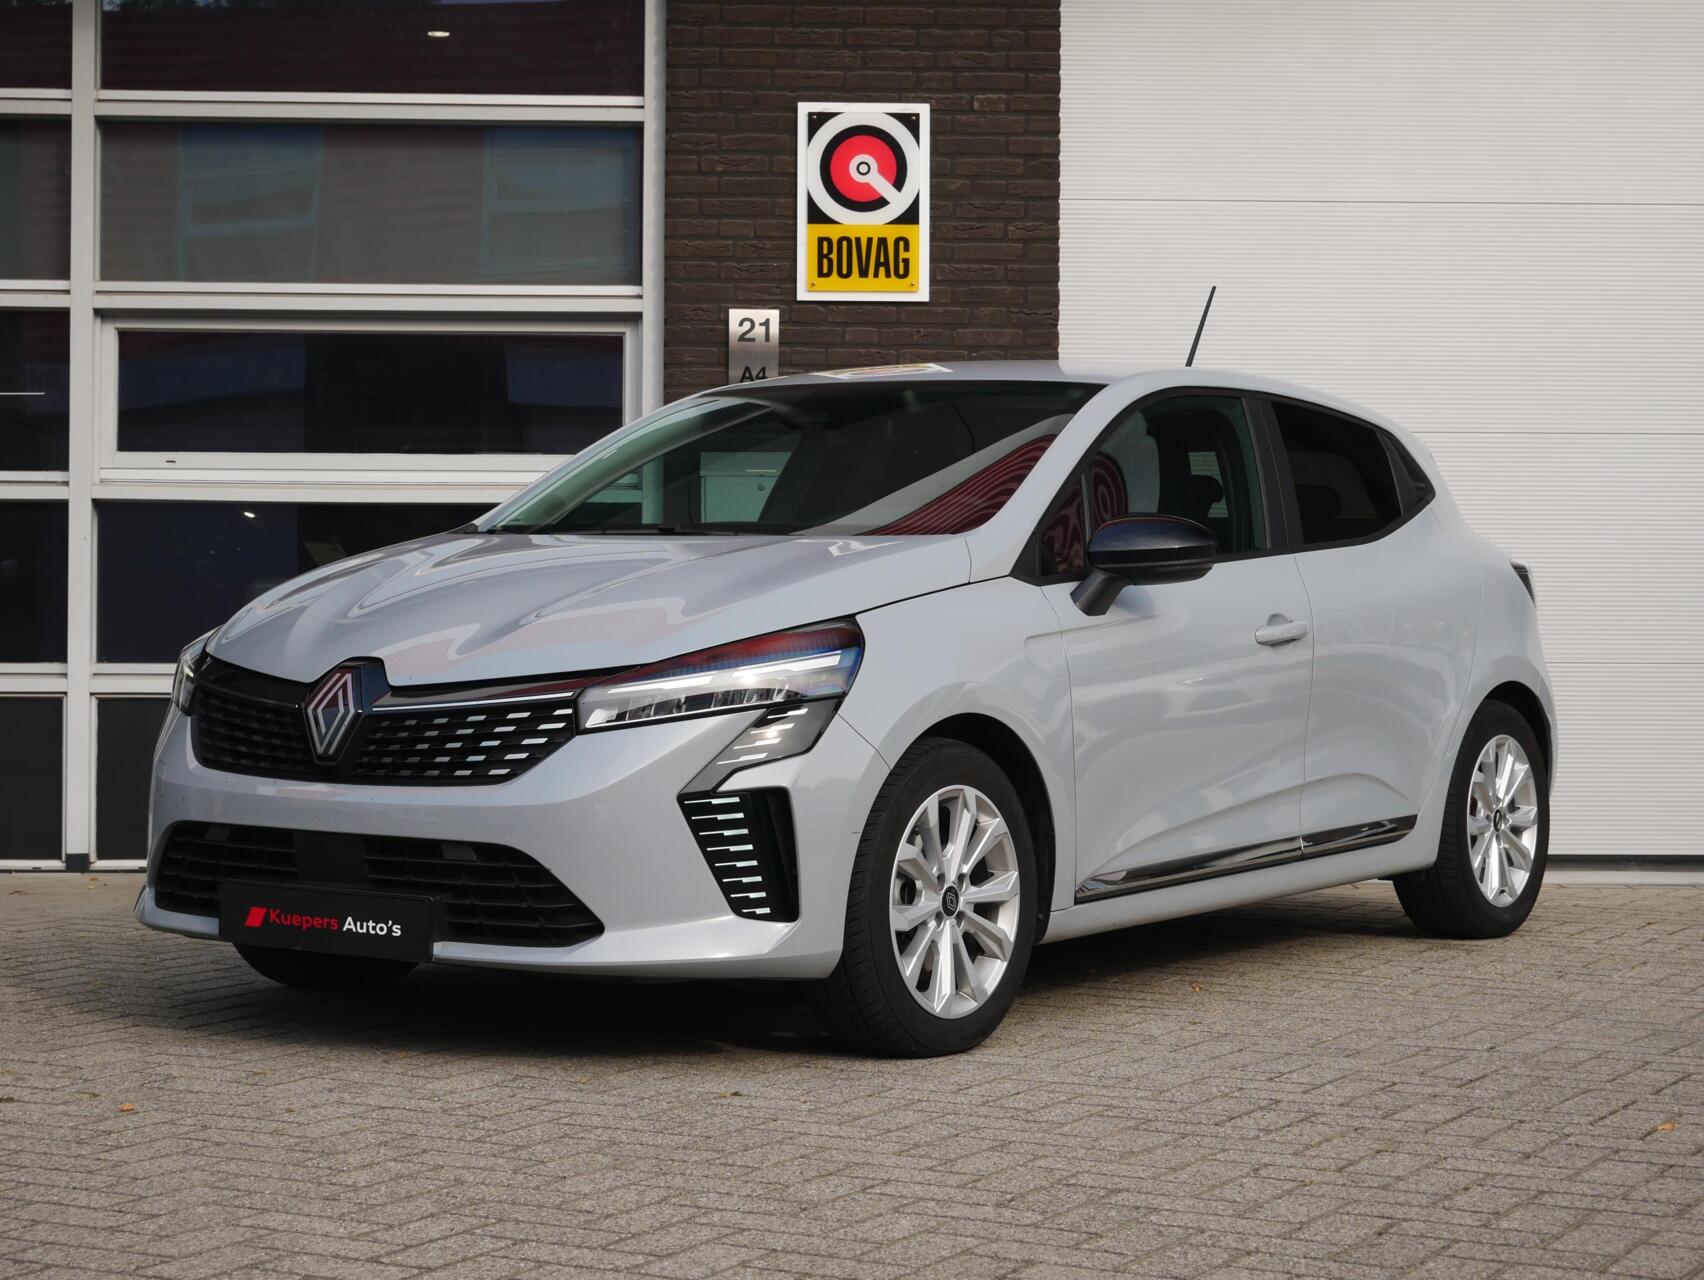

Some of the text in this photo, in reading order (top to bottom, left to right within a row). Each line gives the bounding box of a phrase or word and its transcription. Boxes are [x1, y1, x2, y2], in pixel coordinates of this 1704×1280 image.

[817, 236, 911, 279] BOVAG
[737, 317, 771, 342] 21
[740, 366, 768, 383] A4
[269, 908, 402, 936] Kuepers Auto's
